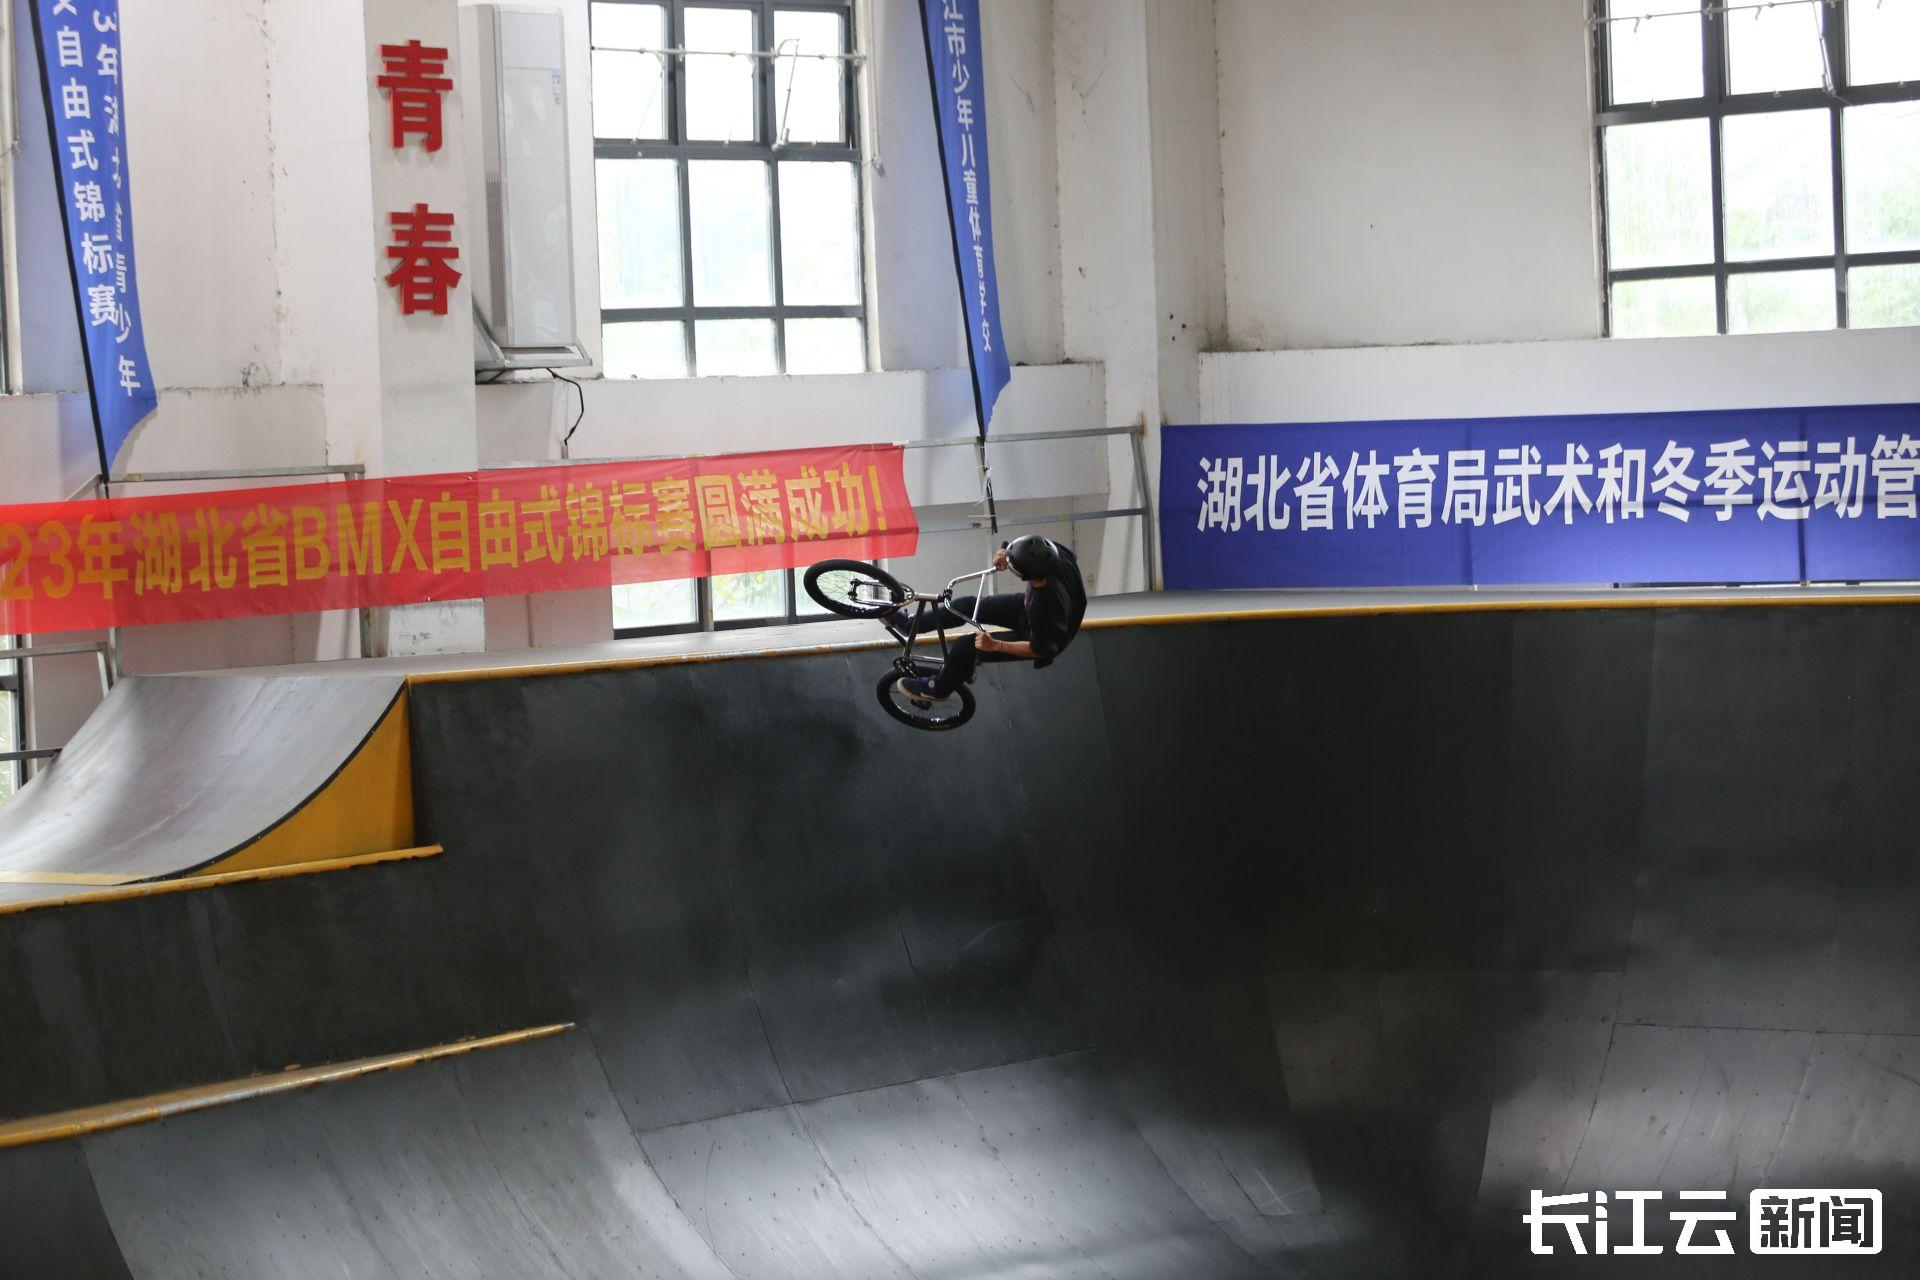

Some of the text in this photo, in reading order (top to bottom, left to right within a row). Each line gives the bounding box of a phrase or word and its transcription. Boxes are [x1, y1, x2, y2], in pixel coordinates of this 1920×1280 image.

[377, 40, 462, 315] 青春
[1196, 433, 1920, 533] 湖北省体育局武术和冬季运动管
